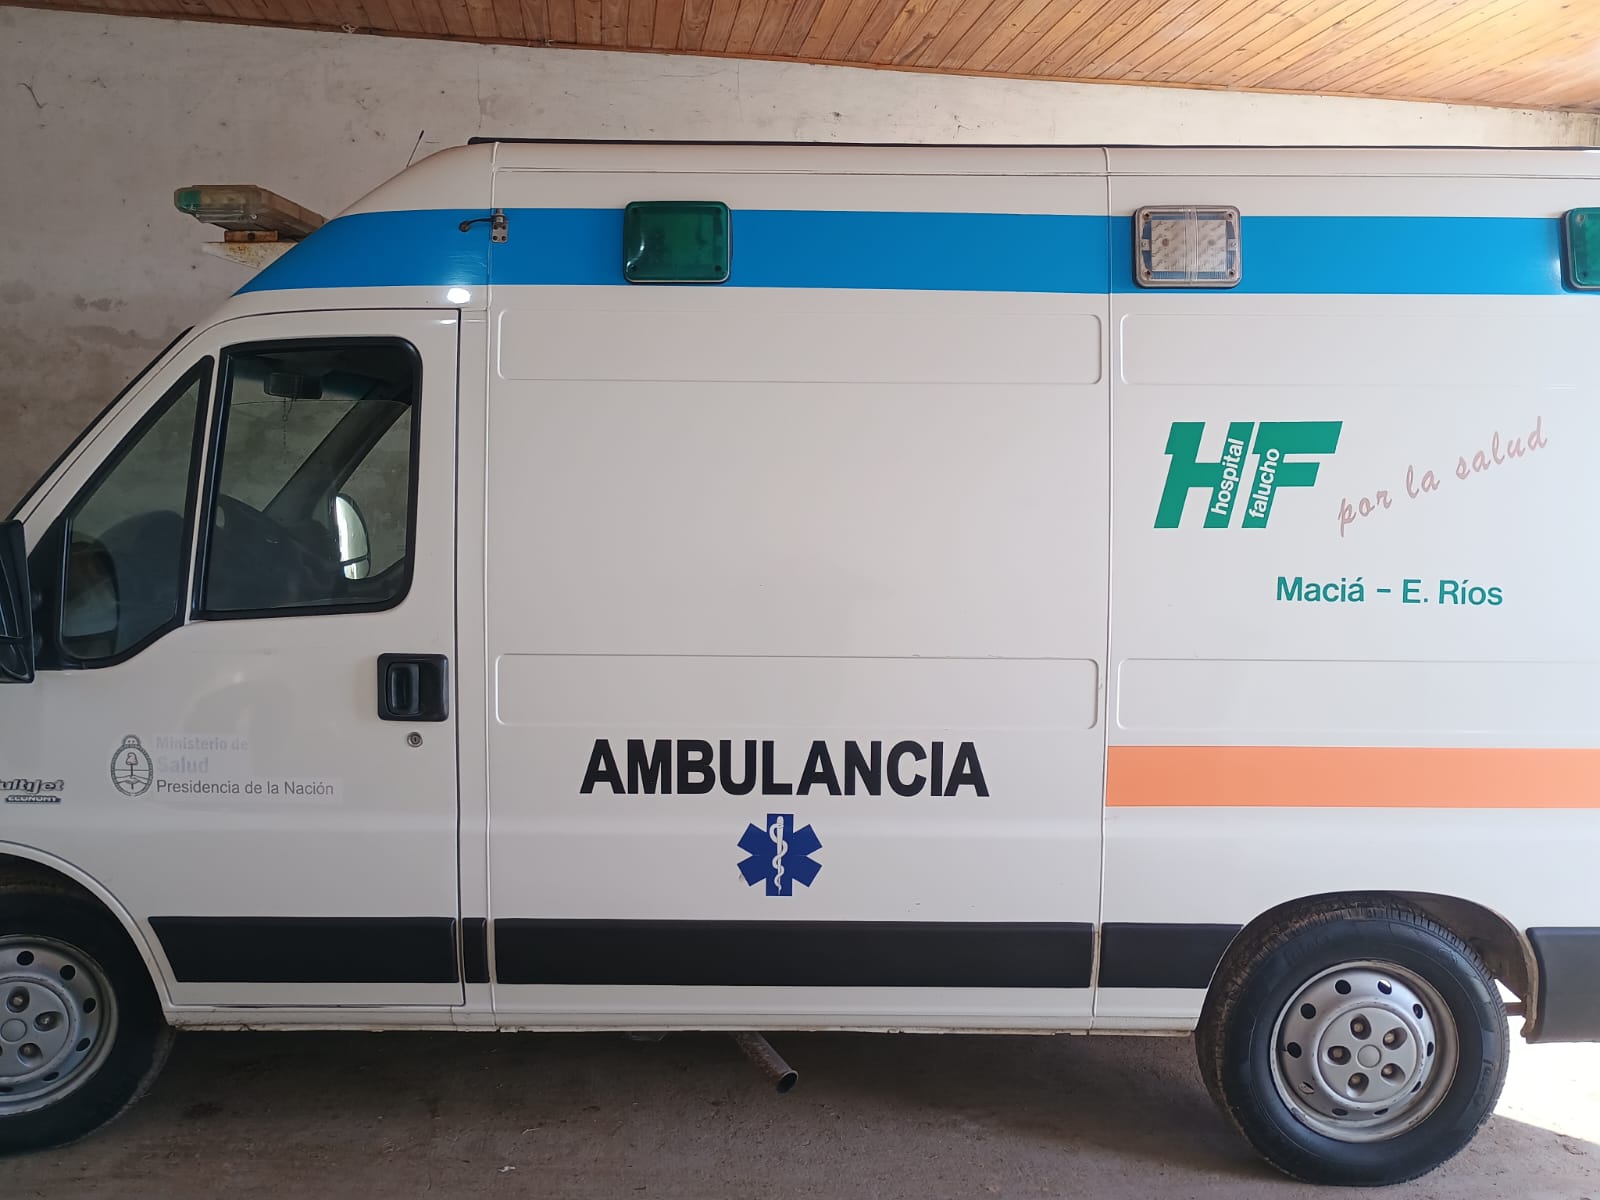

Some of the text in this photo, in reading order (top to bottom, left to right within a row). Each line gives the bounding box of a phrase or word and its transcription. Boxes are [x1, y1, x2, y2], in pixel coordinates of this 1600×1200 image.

[1210, 437, 1245, 516] hospital
[1249, 447, 1280, 519] falucho
[1338, 416, 1549, 537] por la salud
[1276, 577, 1365, 602] Maciá
[1402, 579, 1429, 604] E.
[1438, 579, 1504, 605] Ríos
[155, 736, 249, 751] Ministerio de
[156, 756, 209, 774] Salud
[156, 779, 334, 796] Presidencia de la Nación
[579, 739, 990, 797] AMBULANCIA
